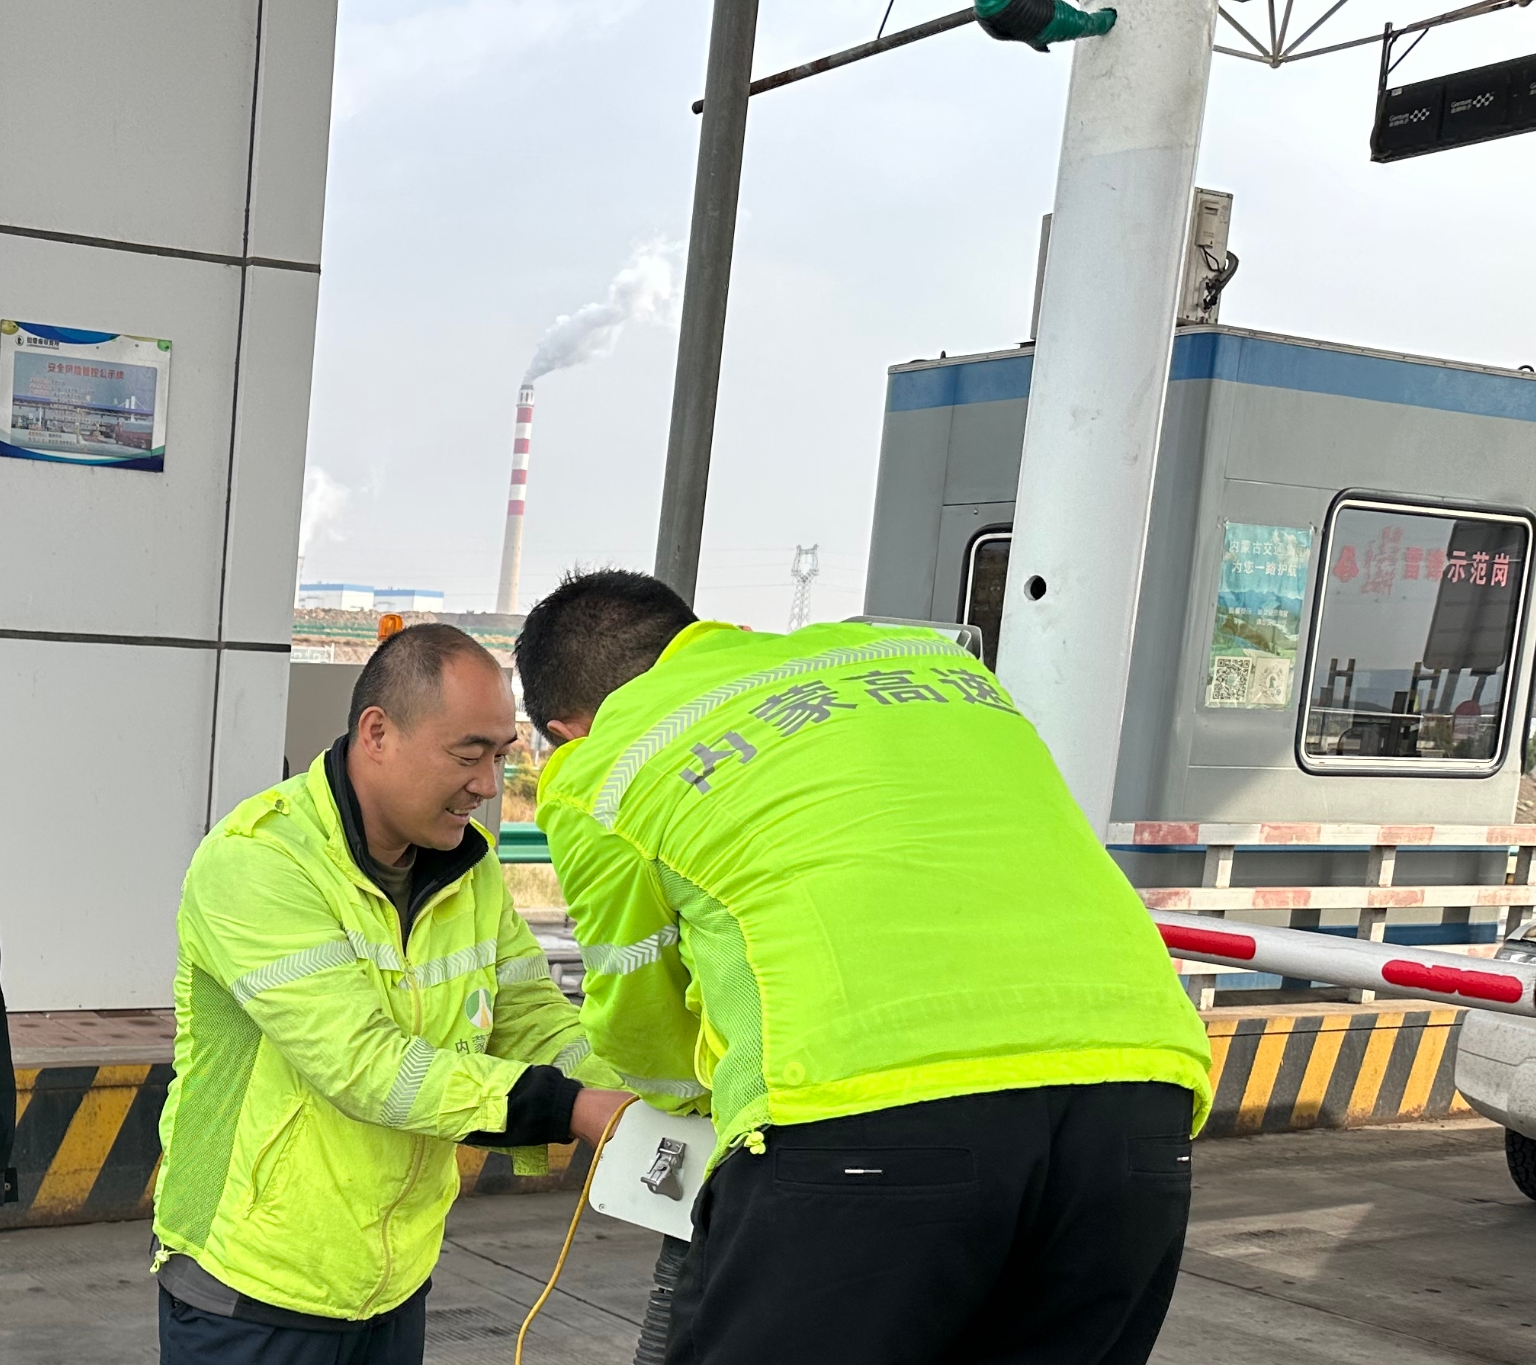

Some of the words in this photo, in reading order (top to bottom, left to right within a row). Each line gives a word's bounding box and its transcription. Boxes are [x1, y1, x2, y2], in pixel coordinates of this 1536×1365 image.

[1231, 560, 1297, 578] 为您一路护航
